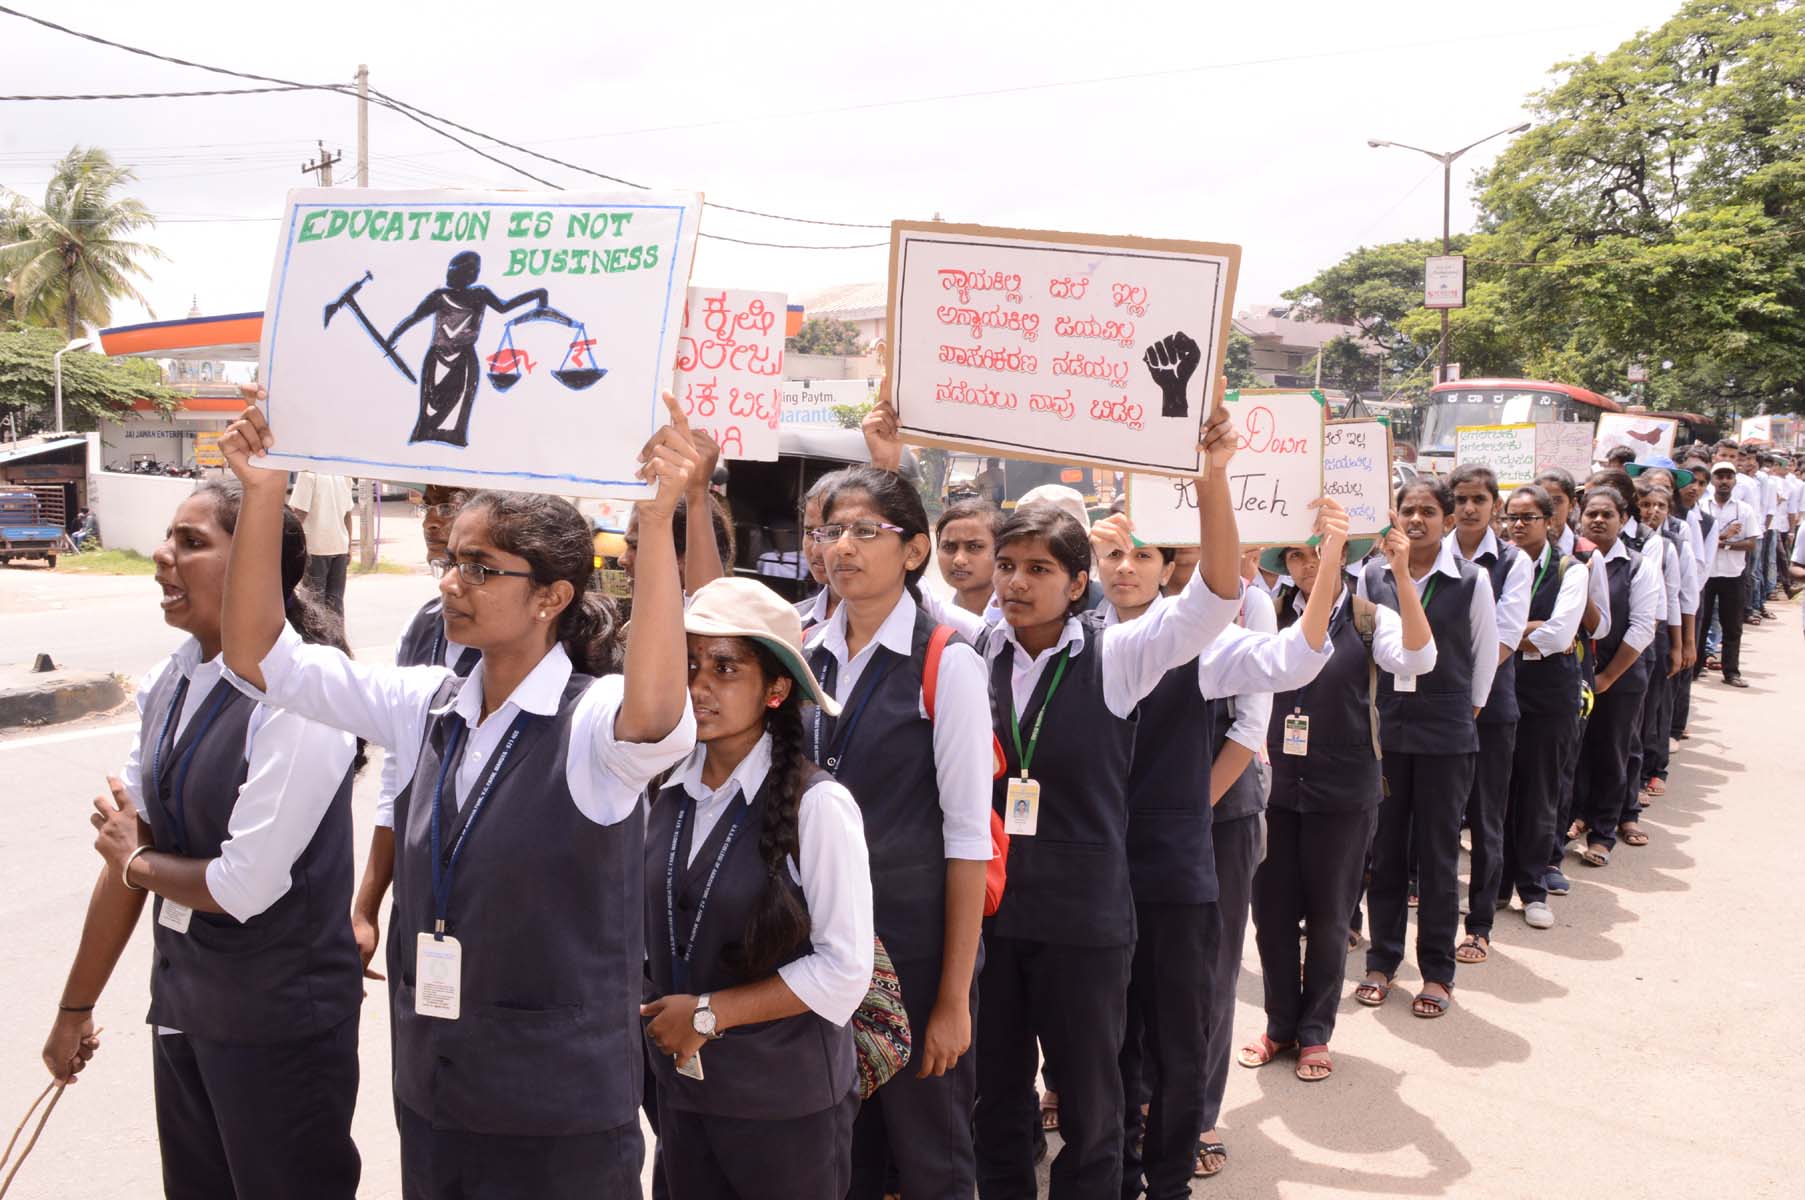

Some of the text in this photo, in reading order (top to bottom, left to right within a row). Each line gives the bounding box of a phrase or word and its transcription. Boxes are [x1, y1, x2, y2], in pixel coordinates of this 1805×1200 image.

[297, 209, 634, 243] EDUCATION IS NOT
[502, 245, 660, 278] BUSINESS
[783, 391, 799, 405] ing
[1236, 406, 1308, 454] Down
[1230, 473, 1288, 516] Tech
